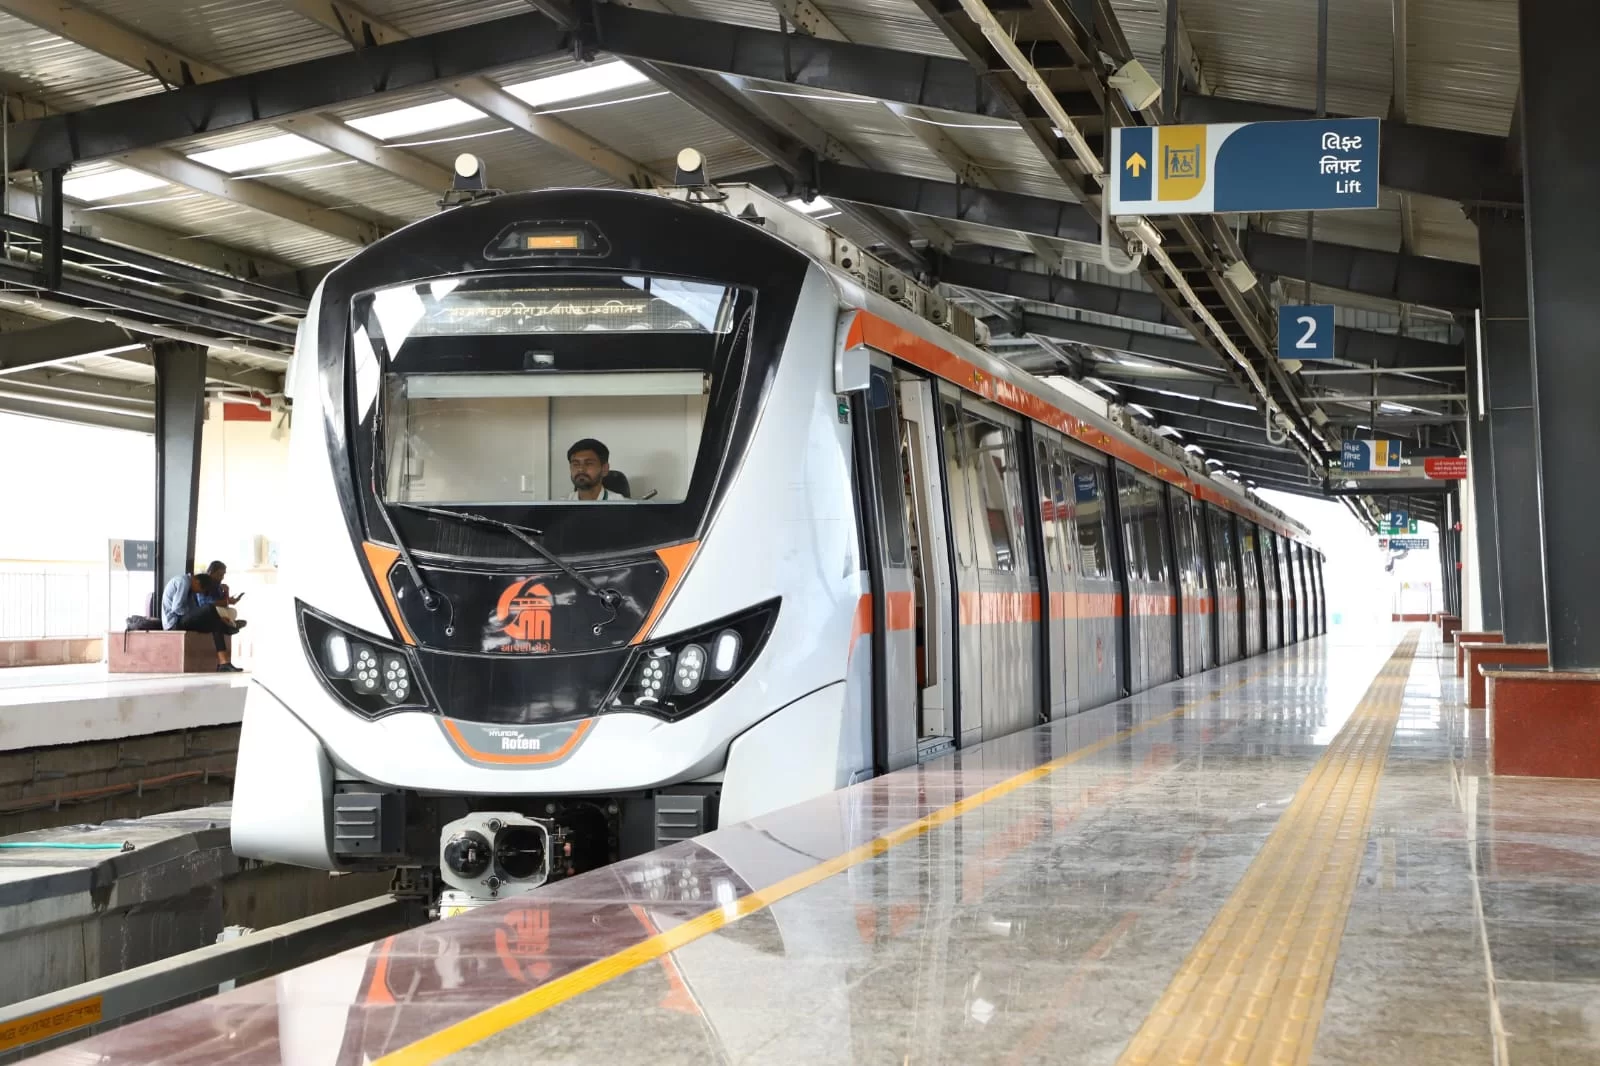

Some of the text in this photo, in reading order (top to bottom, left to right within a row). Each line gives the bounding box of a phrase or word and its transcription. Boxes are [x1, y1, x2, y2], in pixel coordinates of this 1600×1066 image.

[1321, 132, 1362, 152] લિફ્ટ
[1335, 179, 1362, 194] Lift
[1295, 315, 1317, 349] 2
[1343, 461, 1355, 469] Lift
[1395, 514, 1403, 526] 2
[501, 734, 541, 750] Rotem
